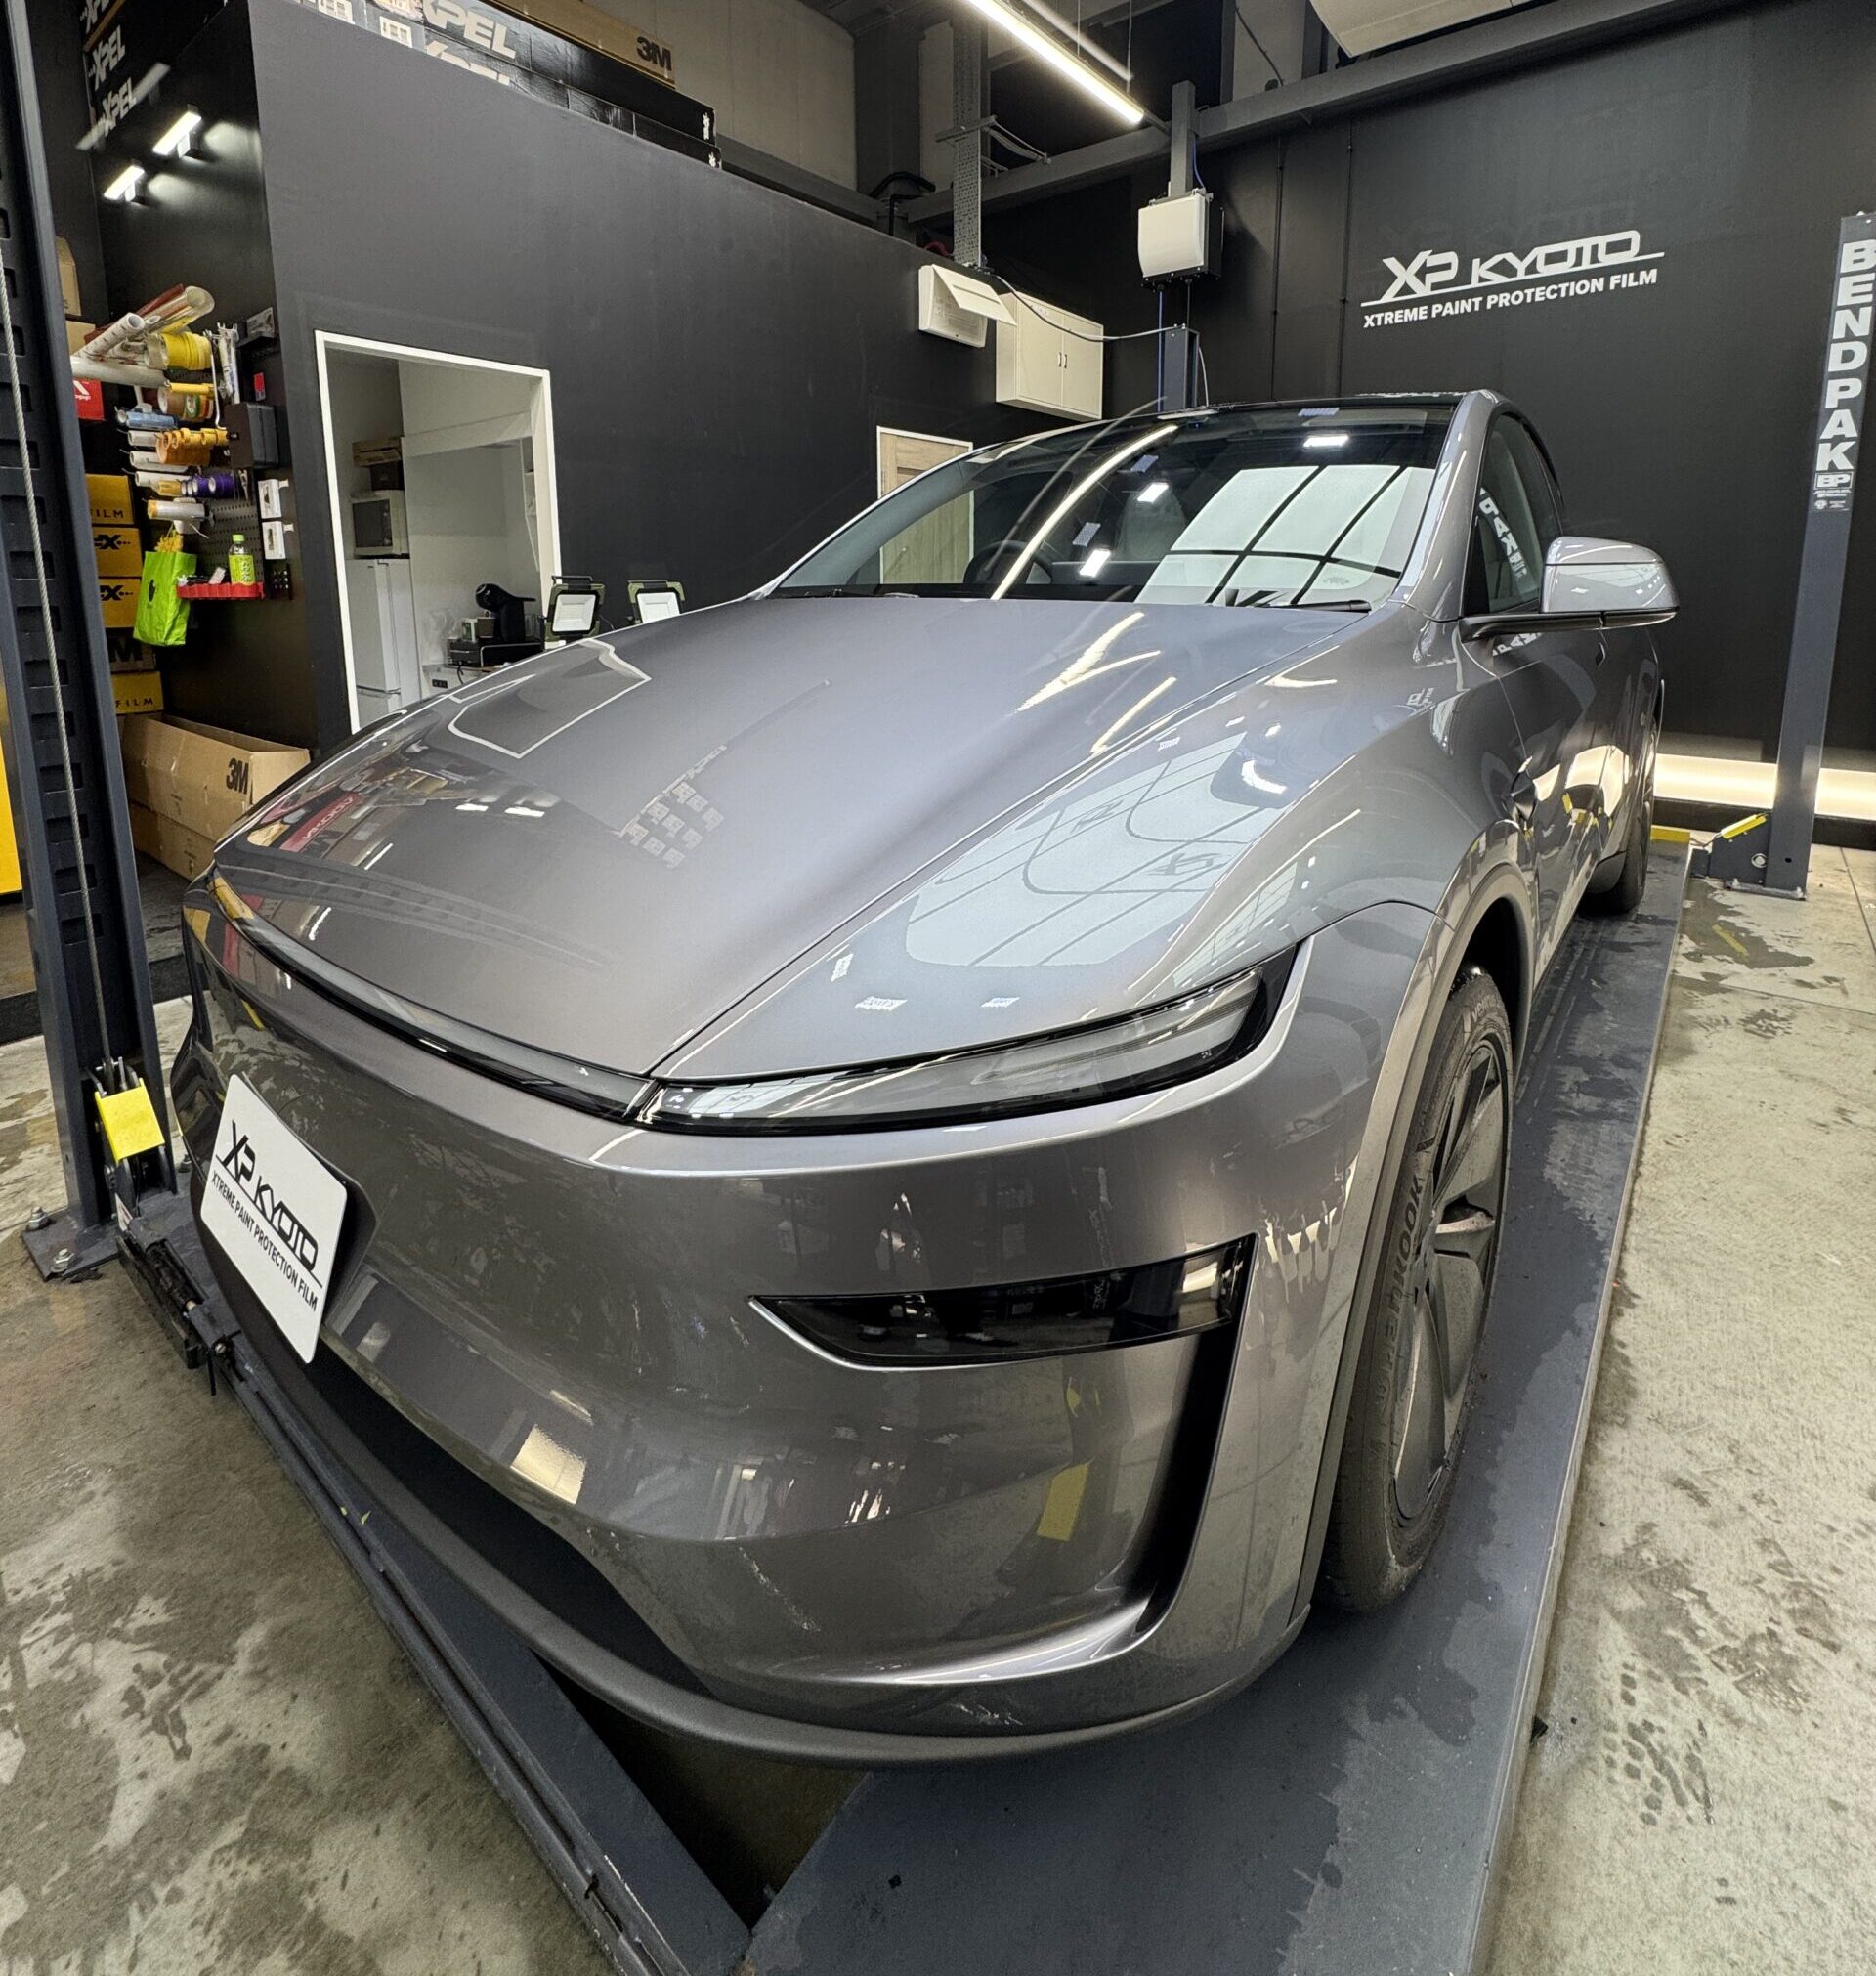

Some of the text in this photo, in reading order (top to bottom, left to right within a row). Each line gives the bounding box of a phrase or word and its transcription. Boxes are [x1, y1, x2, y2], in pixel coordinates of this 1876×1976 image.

[92, 24, 126, 91] XPEL
[637, 36, 672, 71] 3M
[102, 77, 137, 137] XPEL
[1380, 230, 1641, 302] XP KYOTO
[1363, 268, 1658, 328] XTREME PAINT PROTECTION FILM
[1816, 239, 1876, 470] BENDPAK
[108, 637, 143, 663] M
[226, 757, 249, 795] 3M
[223, 1119, 319, 1271] XP KYOTO
[211, 1170, 318, 1312] XTREME PAINT PROTECTION FILM
